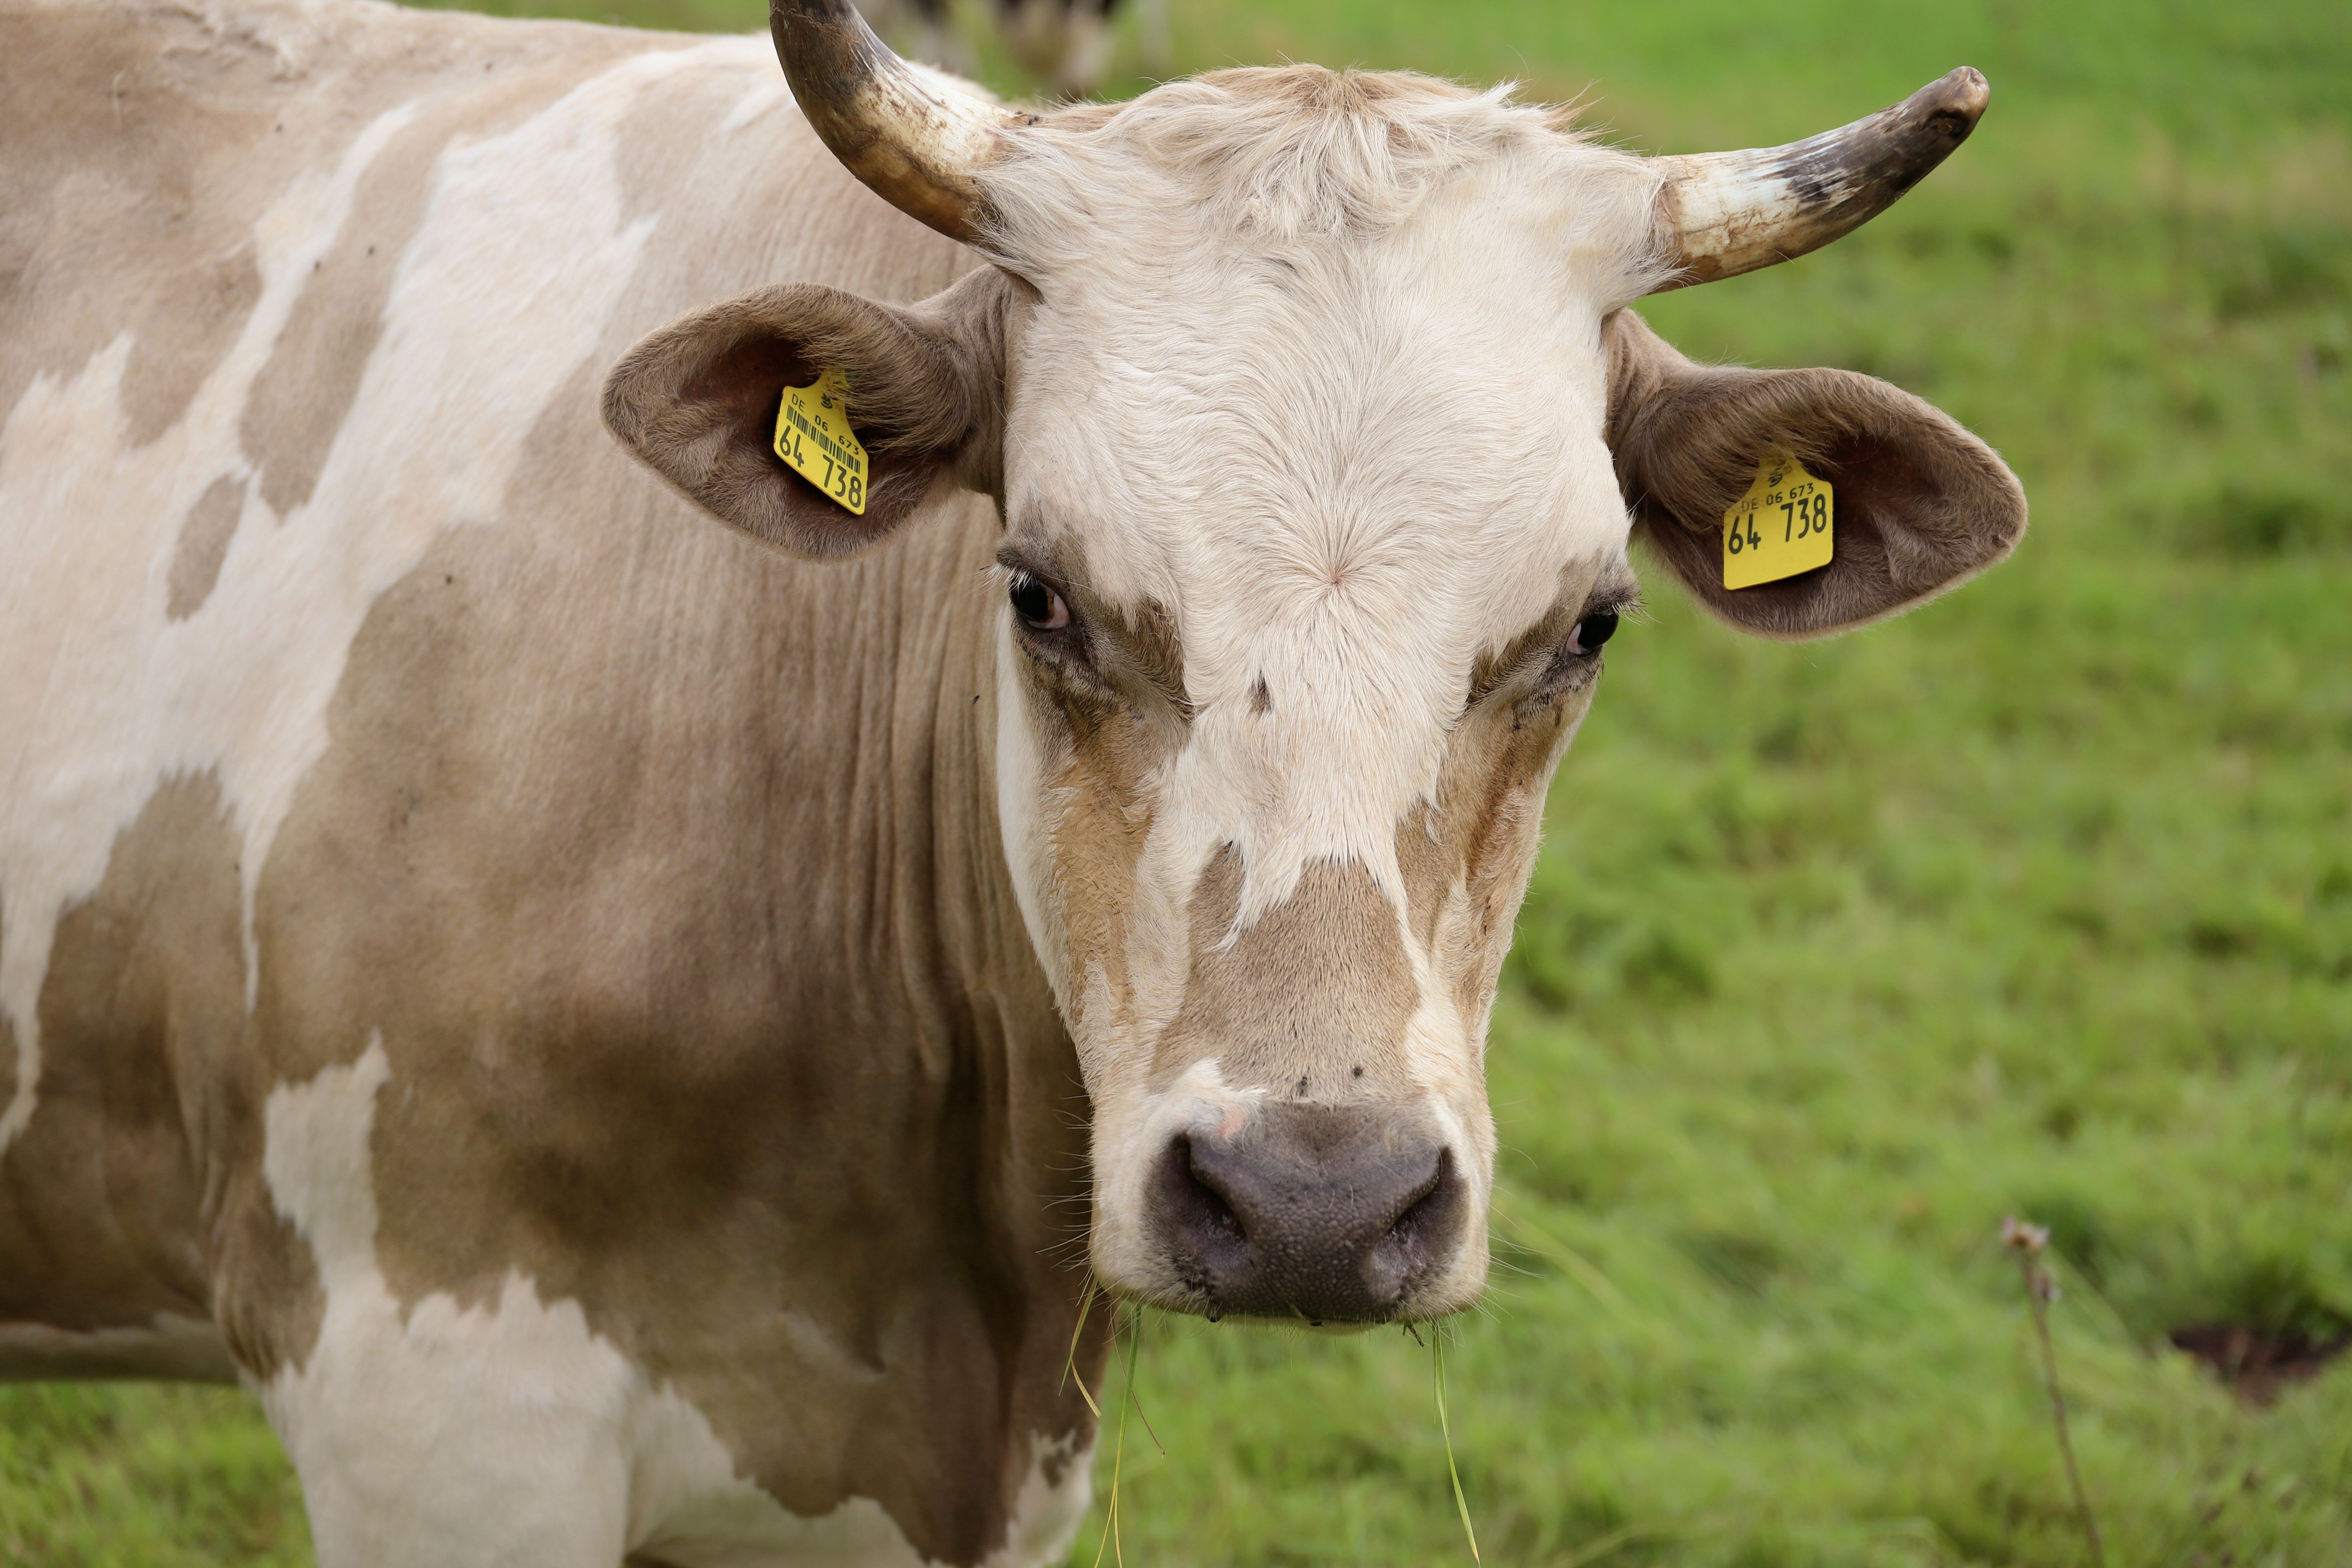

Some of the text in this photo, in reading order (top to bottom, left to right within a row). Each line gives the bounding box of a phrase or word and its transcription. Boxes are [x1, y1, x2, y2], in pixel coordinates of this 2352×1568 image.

[792, 393, 859, 455] DE 06 673
[779, 425, 862, 508] 64 738
[1741, 482, 1814, 512] DE 06 673
[1729, 494, 1827, 554] 64 738
